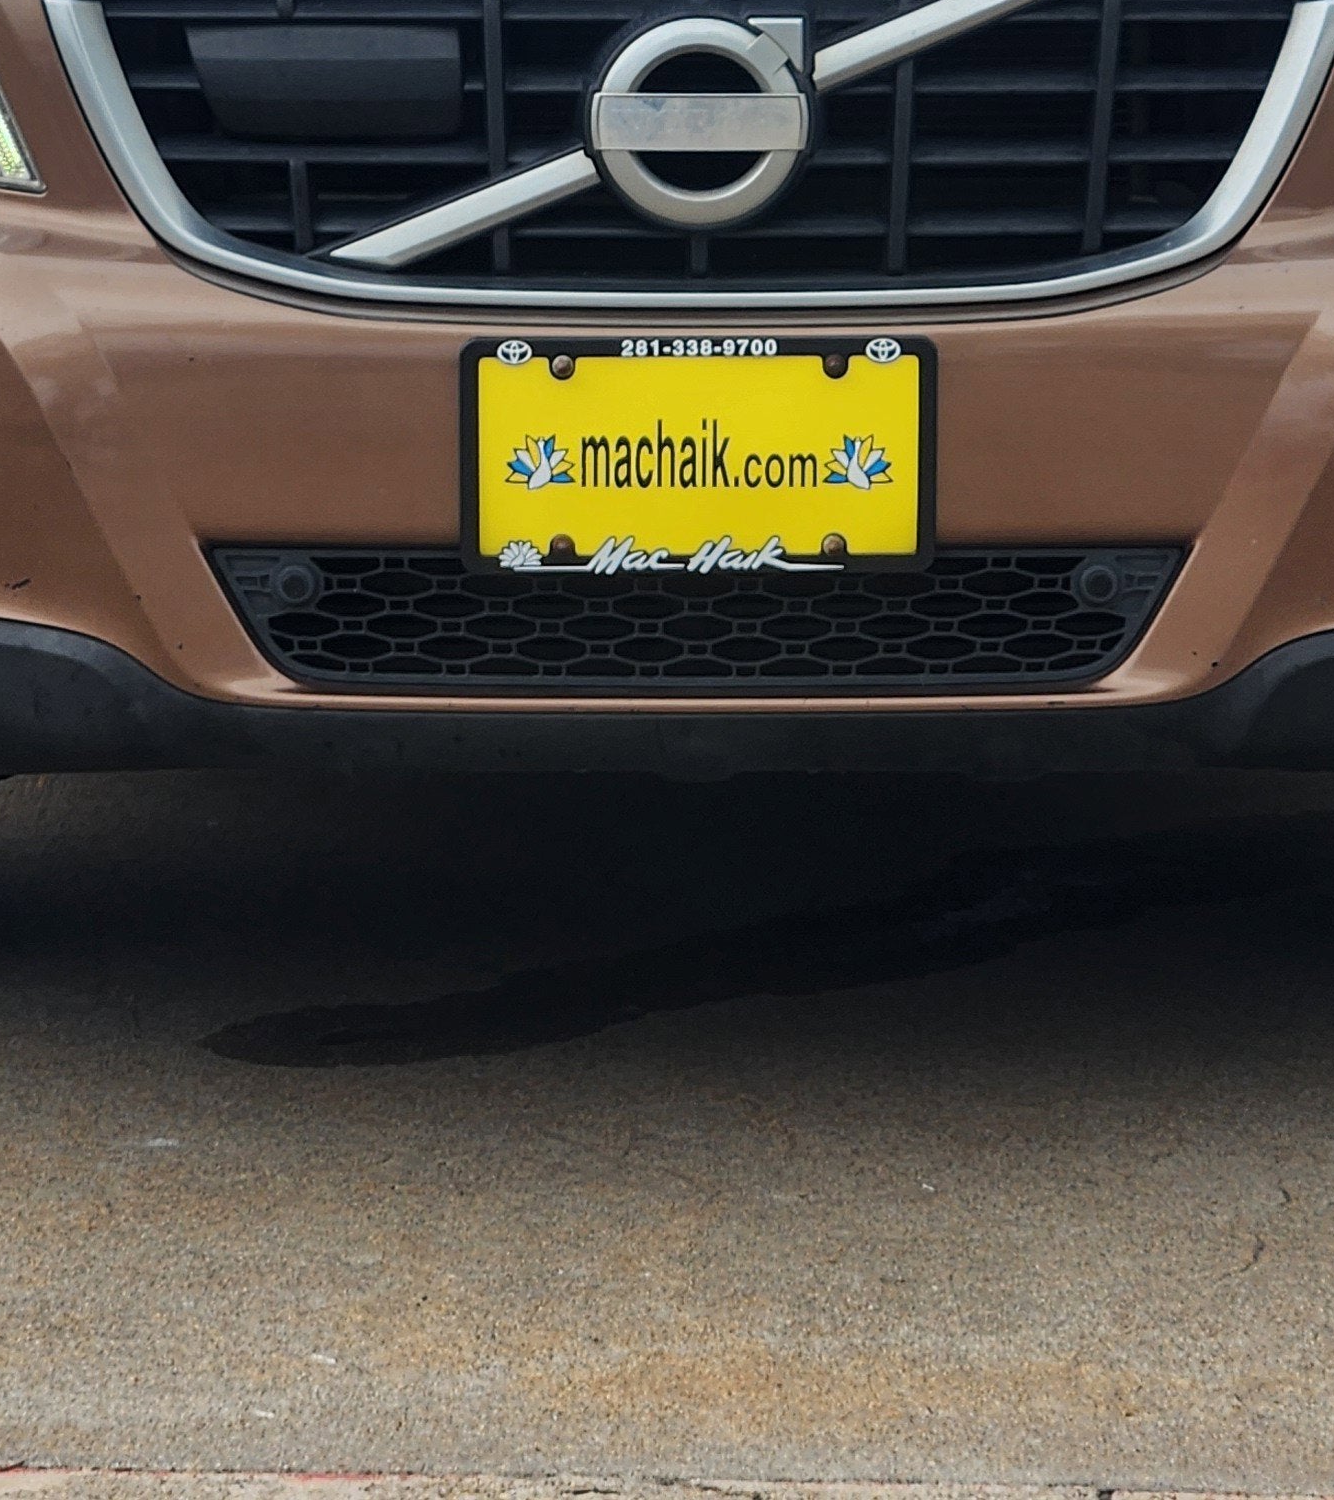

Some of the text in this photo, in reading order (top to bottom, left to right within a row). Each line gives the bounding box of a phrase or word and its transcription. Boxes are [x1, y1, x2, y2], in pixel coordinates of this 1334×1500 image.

[621, 338, 778, 357] 281-338-9700
[580, 418, 818, 489] machaik.com
[586, 535, 787, 575] Mac Haik
